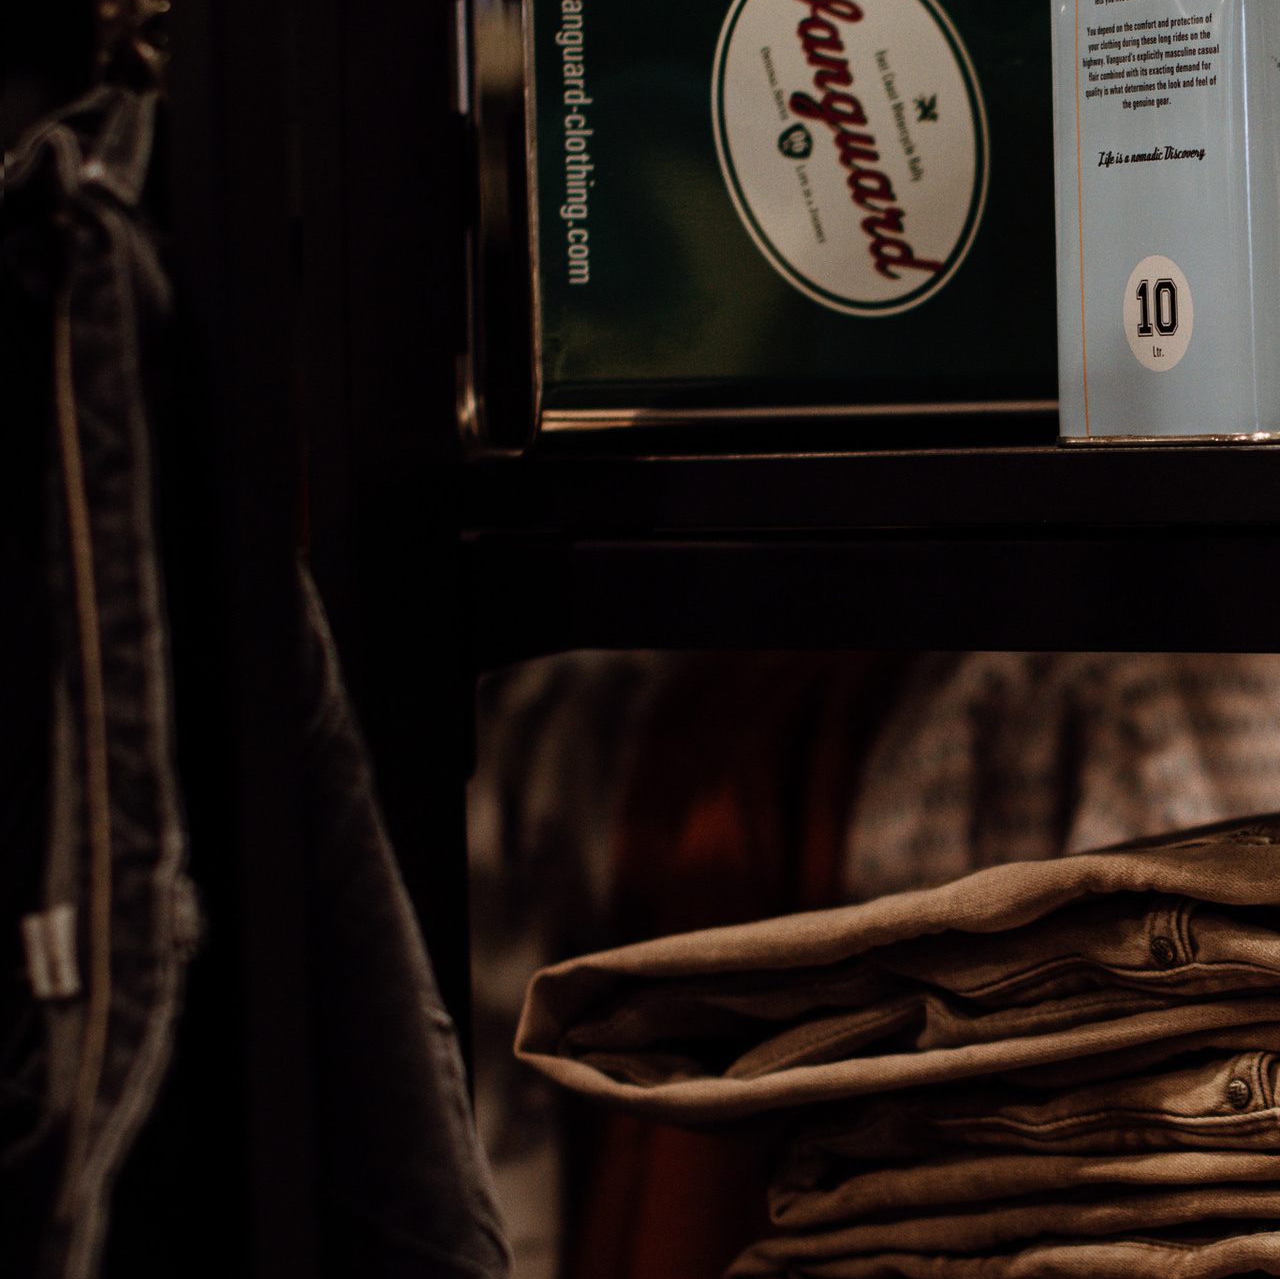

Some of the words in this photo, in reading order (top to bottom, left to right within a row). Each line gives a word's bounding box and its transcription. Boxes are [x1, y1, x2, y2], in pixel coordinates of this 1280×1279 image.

[1088, 43, 1099, 53] your
[1100, 39, 1121, 49] clothing
[1122, 37, 1140, 47] during
[1141, 35, 1157, 44] these
[1158, 34, 1172, 44] long
[1172, 32, 1189, 41] rides
[1199, 29, 1211, 39] the
[1082, 57, 1106, 68] highway.
[1106, 52, 1136, 65] Vanguard's
[1137, 49, 1163, 62] explicitly
[1165, 47, 1196, 57] masculine
[1197, 44, 1220, 54] casual
[1100, 69, 1125, 79] combined
[1126, 67, 1139, 77] with
[1139, 66, 1148, 75] its
[1149, 64, 1174, 75] exacting
[1176, 61, 1200, 72] demand
[1201, 60, 1211, 70] for
[1097, 150, 1115, 168] Life
[1115, 151, 1123, 164] is
[1124, 154, 1130, 163] a
[1130, 147, 1163, 163] nomadic
[1164, 145, 1206, 162] Discovery
[1136, 278, 1179, 338] 10
[1152, 345, 1165, 359] Ltr.
